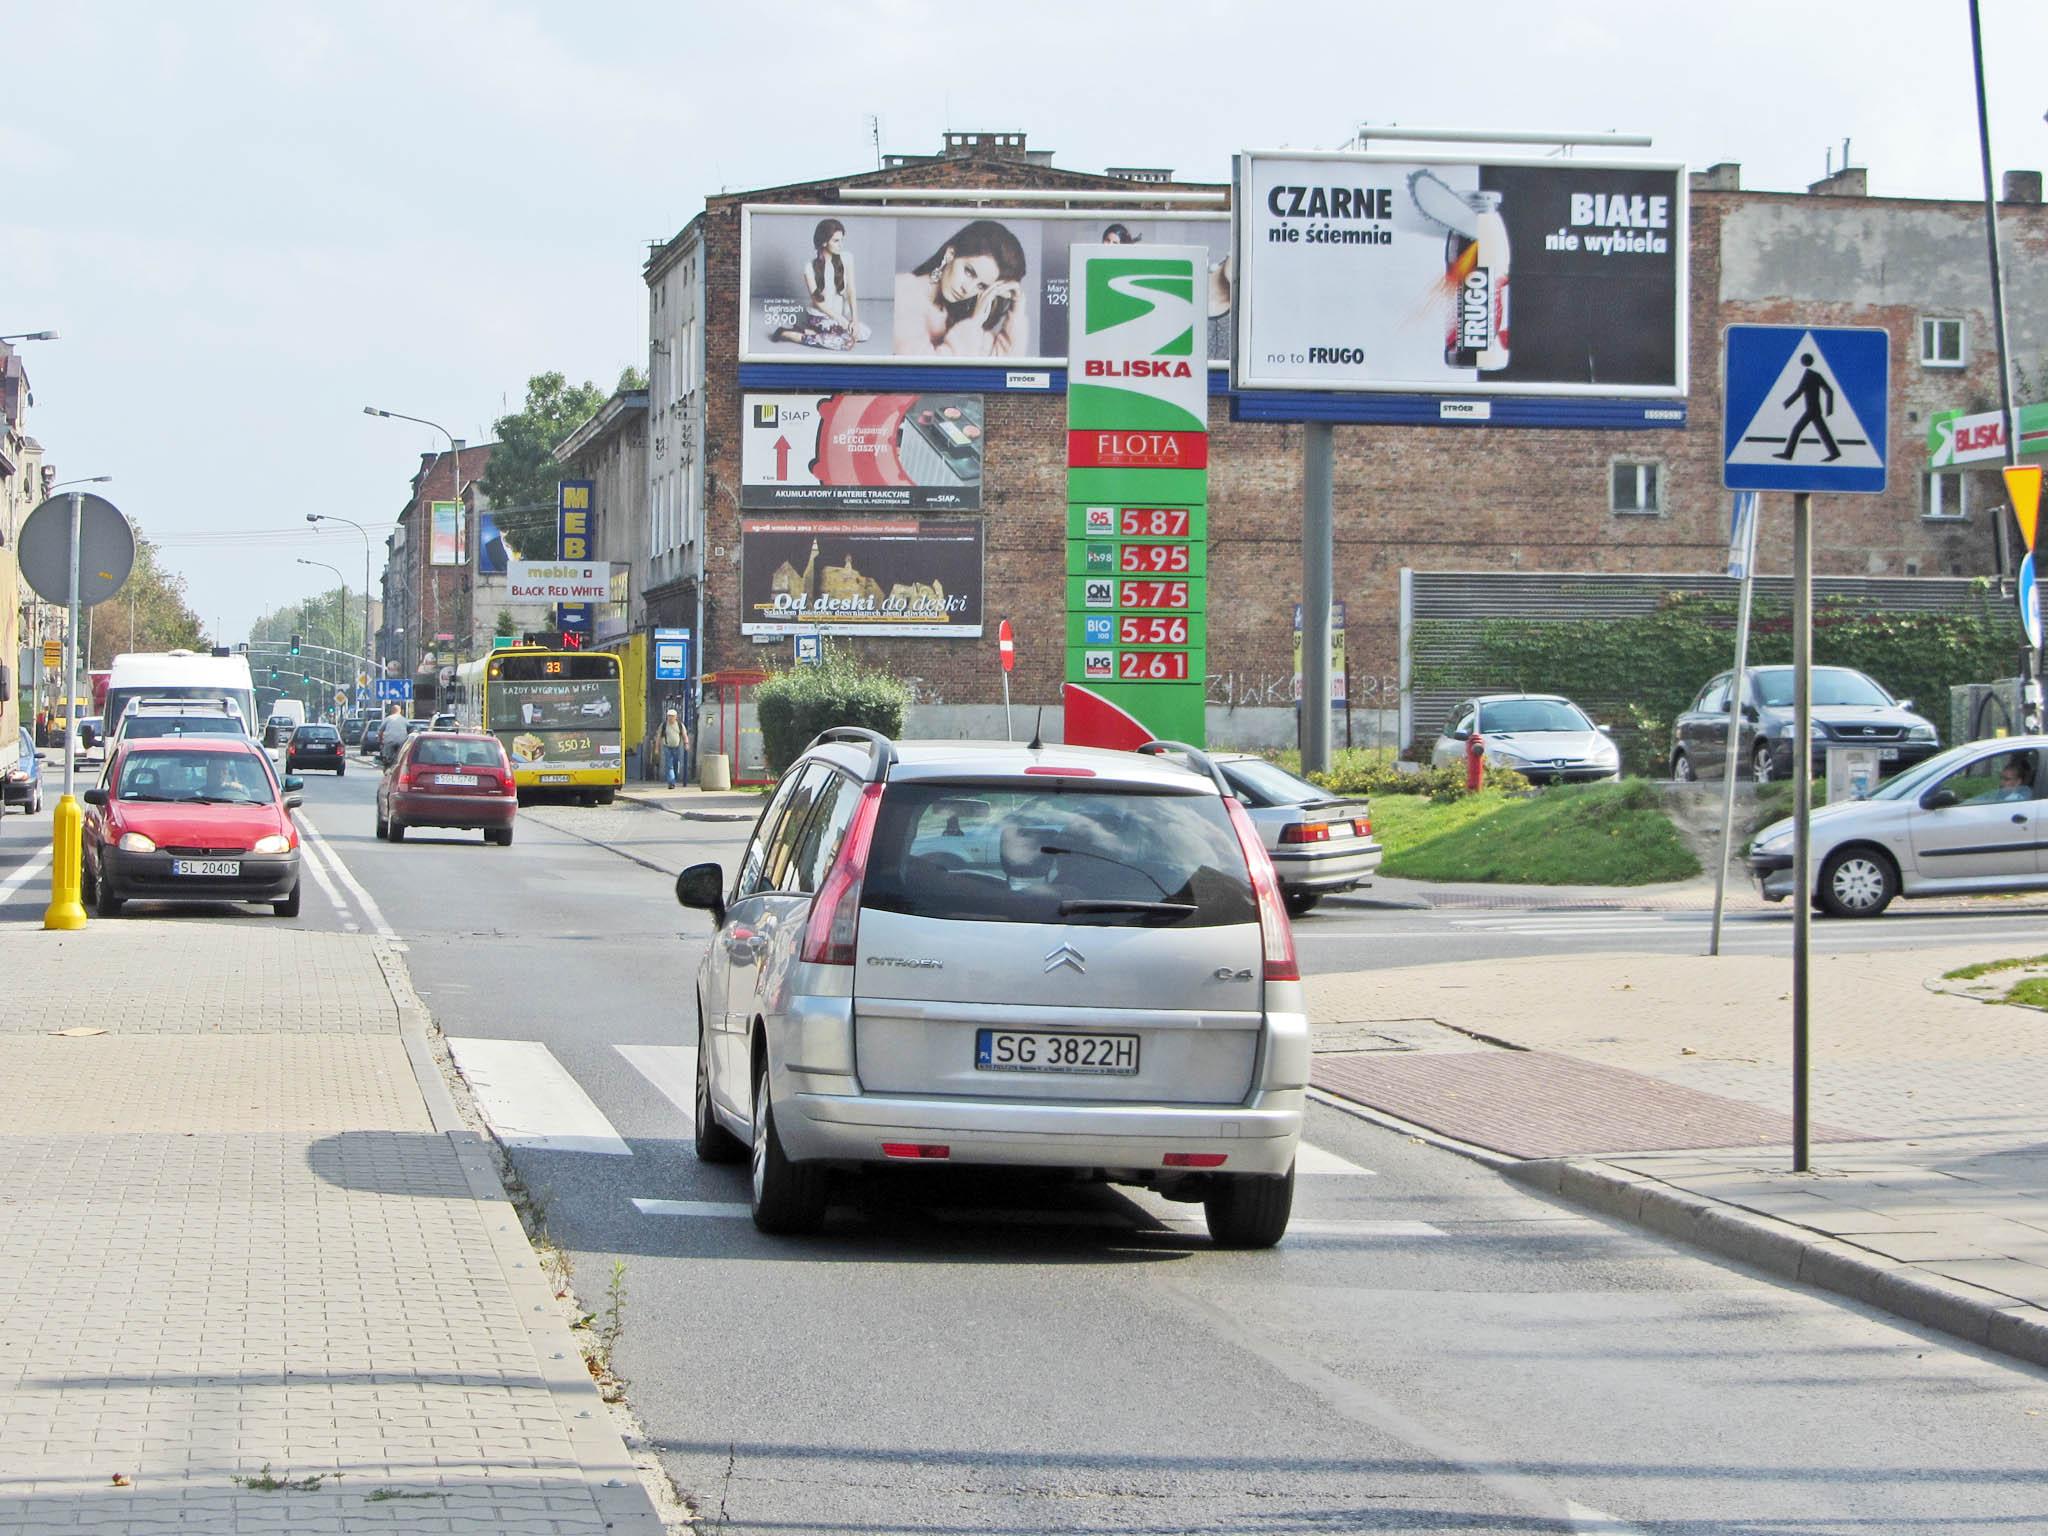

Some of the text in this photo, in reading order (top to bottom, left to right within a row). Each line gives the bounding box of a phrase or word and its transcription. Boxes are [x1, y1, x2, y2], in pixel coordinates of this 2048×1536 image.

[1268, 185, 1393, 220] CZARNE
[1570, 193, 1668, 229] BIAŁE
[1269, 222, 1393, 246] nie ściemnia
[1545, 228, 1667, 256] nie wybiela
[1463, 270, 1488, 348] FRUGO
[1267, 347, 1364, 365] no to FRUGO
[1085, 360, 1192, 378] BLISKA
[781, 411, 810, 421] SIAP
[1098, 434, 1179, 455] FLOTA
[775, 490, 832, 498] AKUMULATORY
[837, 490, 867, 498] BATERIE
[868, 490, 910, 498] TRAKCYJNE
[1091, 511, 1109, 526] 95
[1121, 510, 1187, 535] 5,87
[1121, 546, 1187, 571] 5,95
[512, 585, 605, 597] BLACK RED WHITE
[774, 591, 968, 613] Od deski do deski
[1087, 582, 1187, 607] ON 5,75
[1087, 618, 1187, 643] BIO 5,56
[545, 661, 562, 673] 33
[1087, 653, 1185, 679] LPG 2,61
[181, 862, 238, 875] SL 20405
[1213, 966, 1254, 981] C4
[996, 1035, 1133, 1067] SG 3822H
